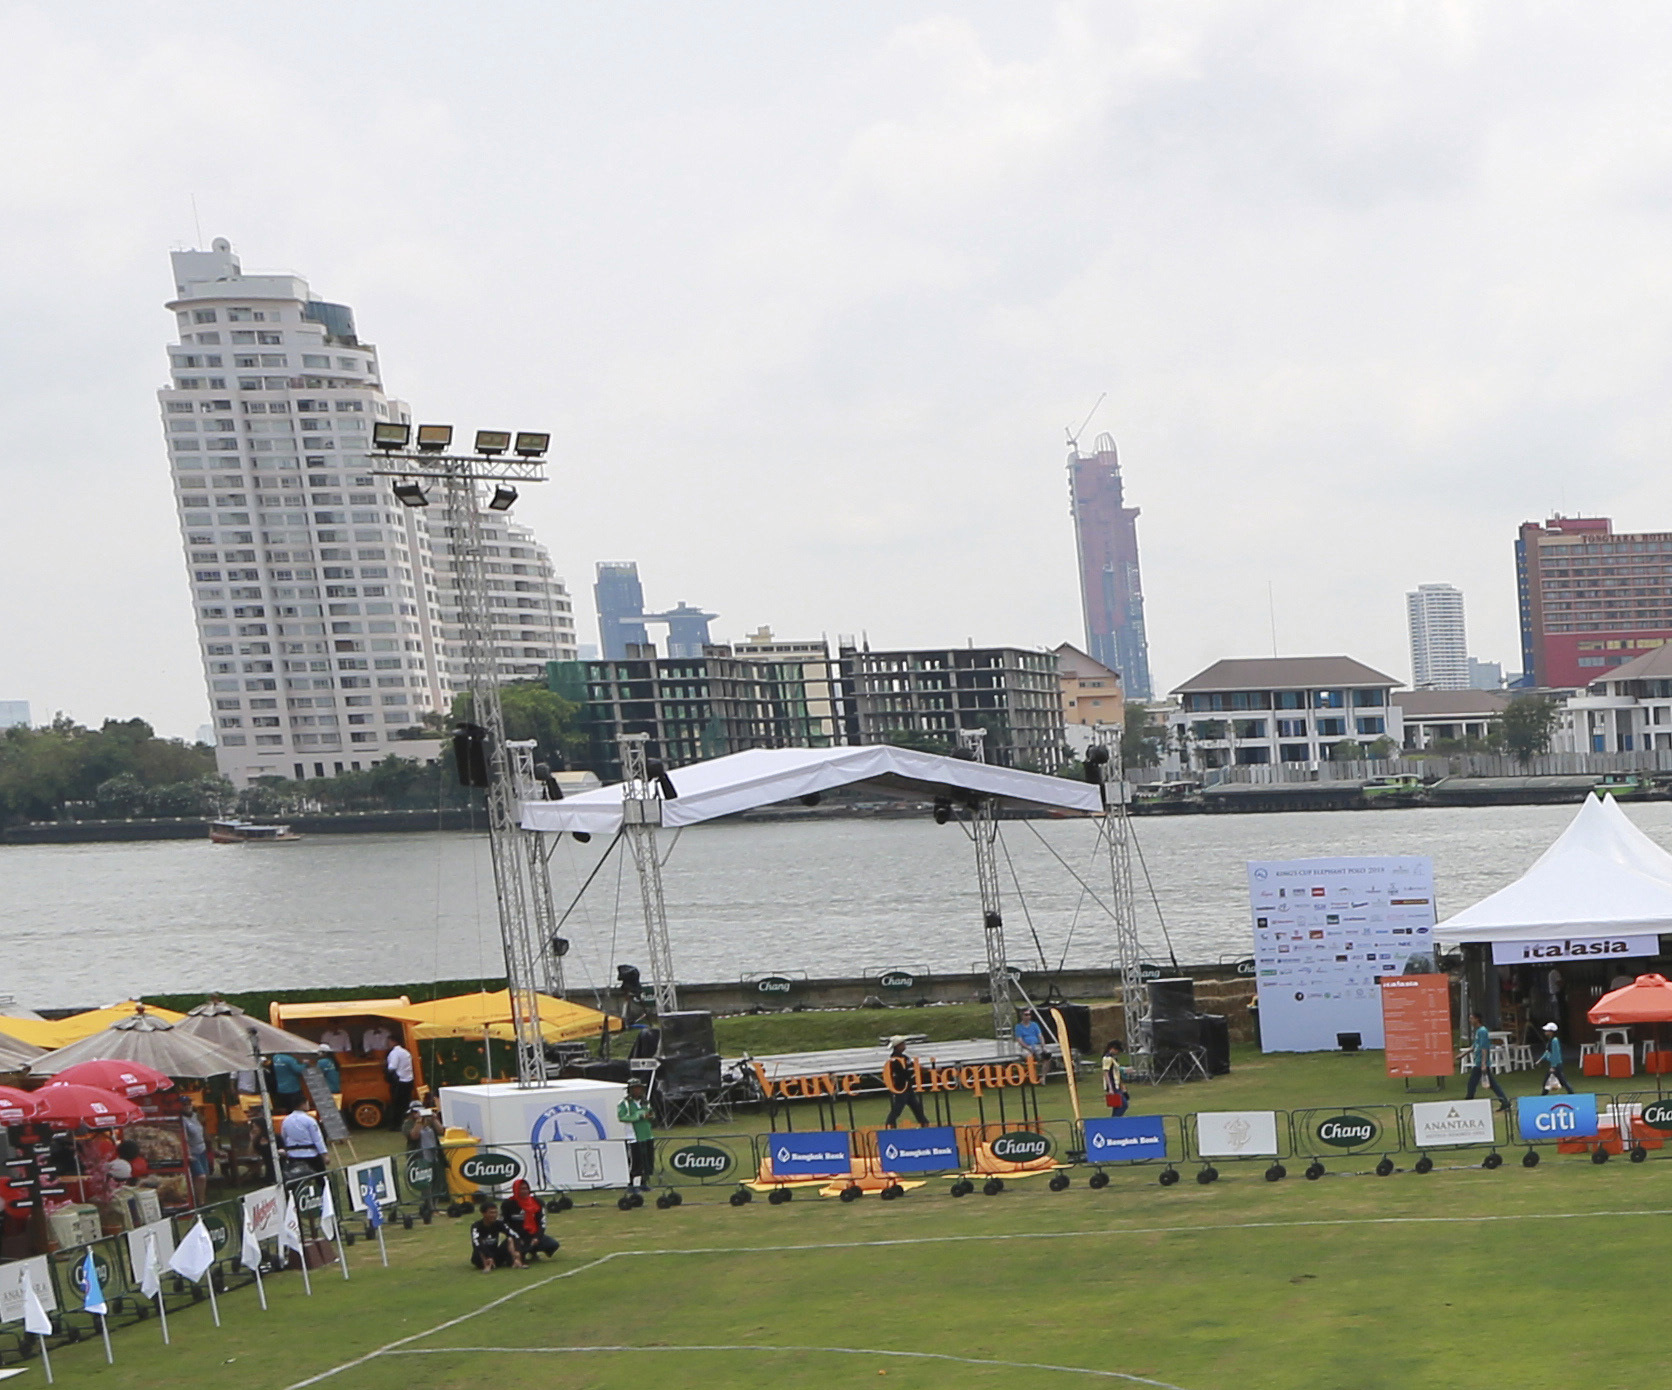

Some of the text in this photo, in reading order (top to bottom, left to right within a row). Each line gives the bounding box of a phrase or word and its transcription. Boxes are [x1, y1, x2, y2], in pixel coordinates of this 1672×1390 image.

[1523, 940, 1630, 959] italasia
[1237, 963, 1255, 974] Cha
[759, 981, 790, 993] Chang
[881, 976, 914, 987] Chang
[752, 1054, 1043, 1098] Veuve Clicquot
[1424, 1119, 1485, 1130] ANANTARA
[1535, 1107, 1575, 1132] citi
[1320, 1122, 1371, 1142] Chang
[995, 1138, 1046, 1156] Chang
[1107, 1136, 1160, 1147] Bangkok Bank
[792, 1152, 845, 1162] Bangkok Bank
[900, 1147, 952, 1158] Bangkok Bank
[674, 1152, 726, 1171] Chang
[463, 1162, 515, 1178] Chang
